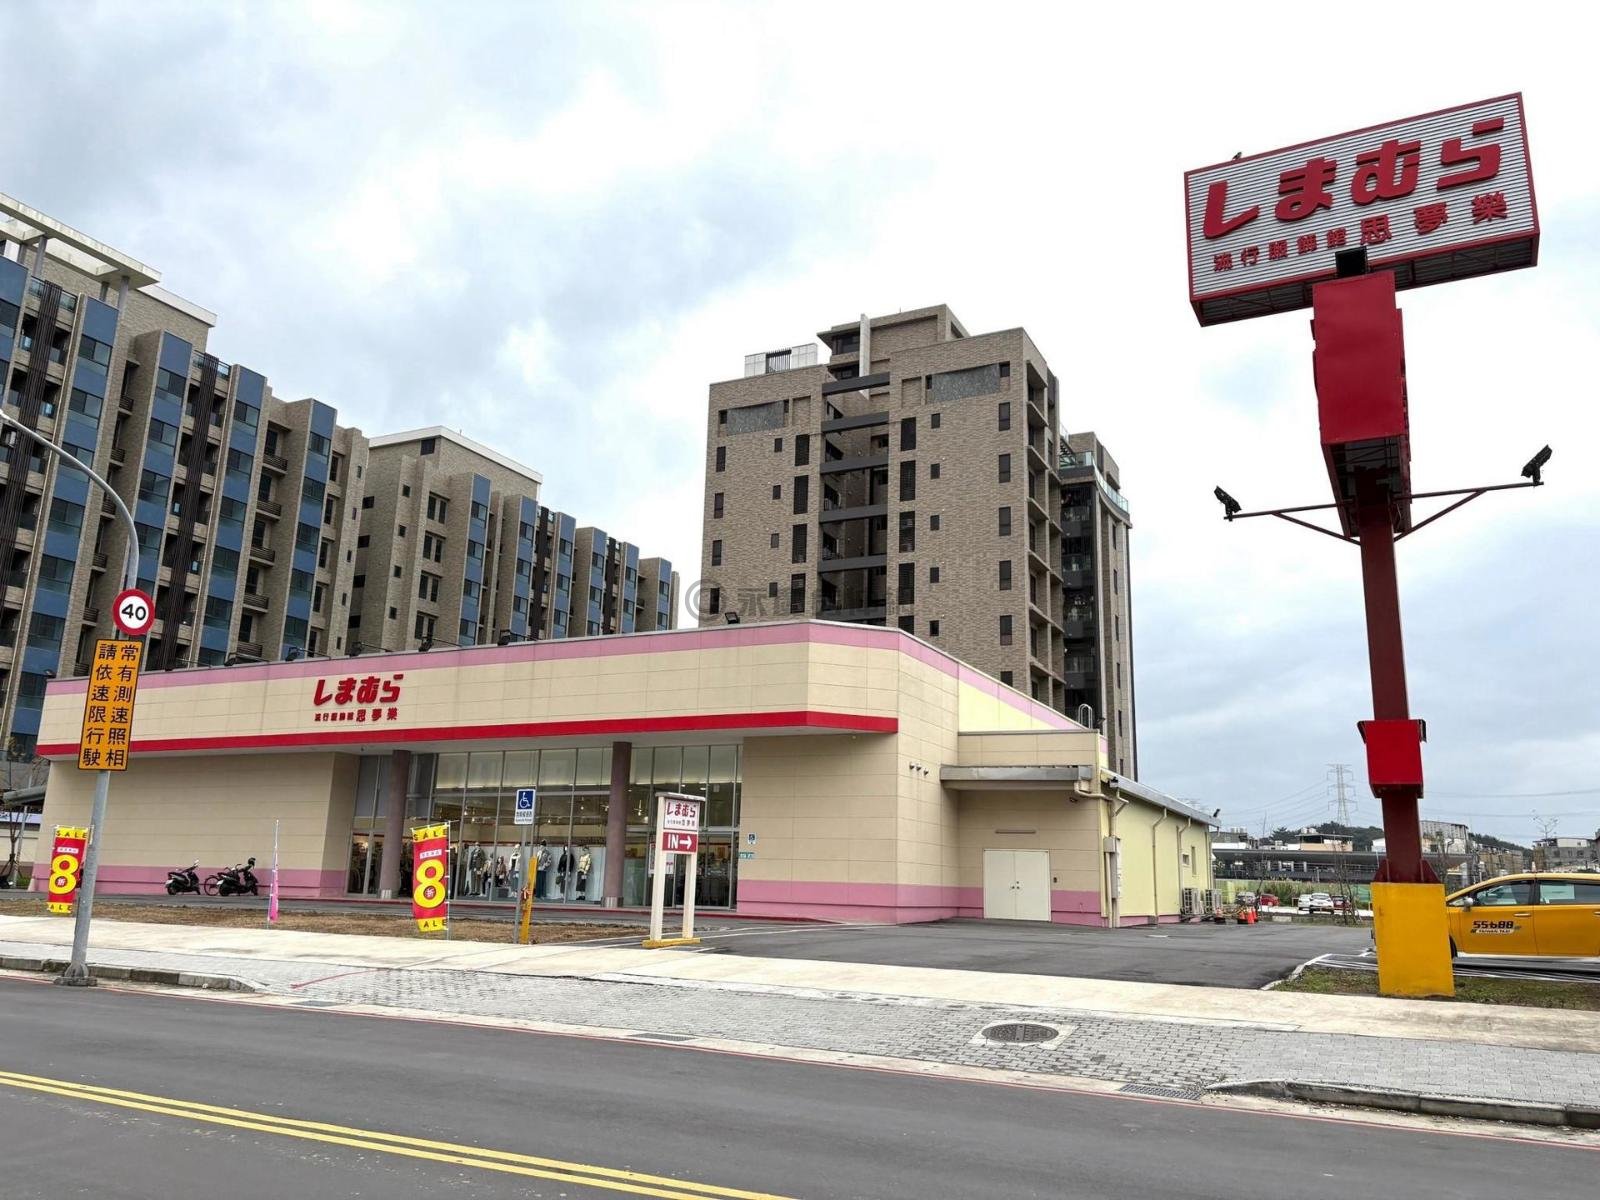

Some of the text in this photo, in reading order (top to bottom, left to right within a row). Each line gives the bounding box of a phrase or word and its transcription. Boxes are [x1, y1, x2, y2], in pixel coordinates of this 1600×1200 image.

[1203, 117, 1504, 240] しまむら
[121, 603, 147, 621] 40
[313, 674, 404, 706] しまむら
[82, 643, 118, 767] 請依速限行駛
[104, 644, 139, 767] 常有測速照相
[666, 801, 697, 818] しまむら
[56, 831, 88, 839] SALE
[413, 828, 448, 841] SALE
[667, 833, 679, 849] IN
[1473, 920, 1514, 929] 55688
